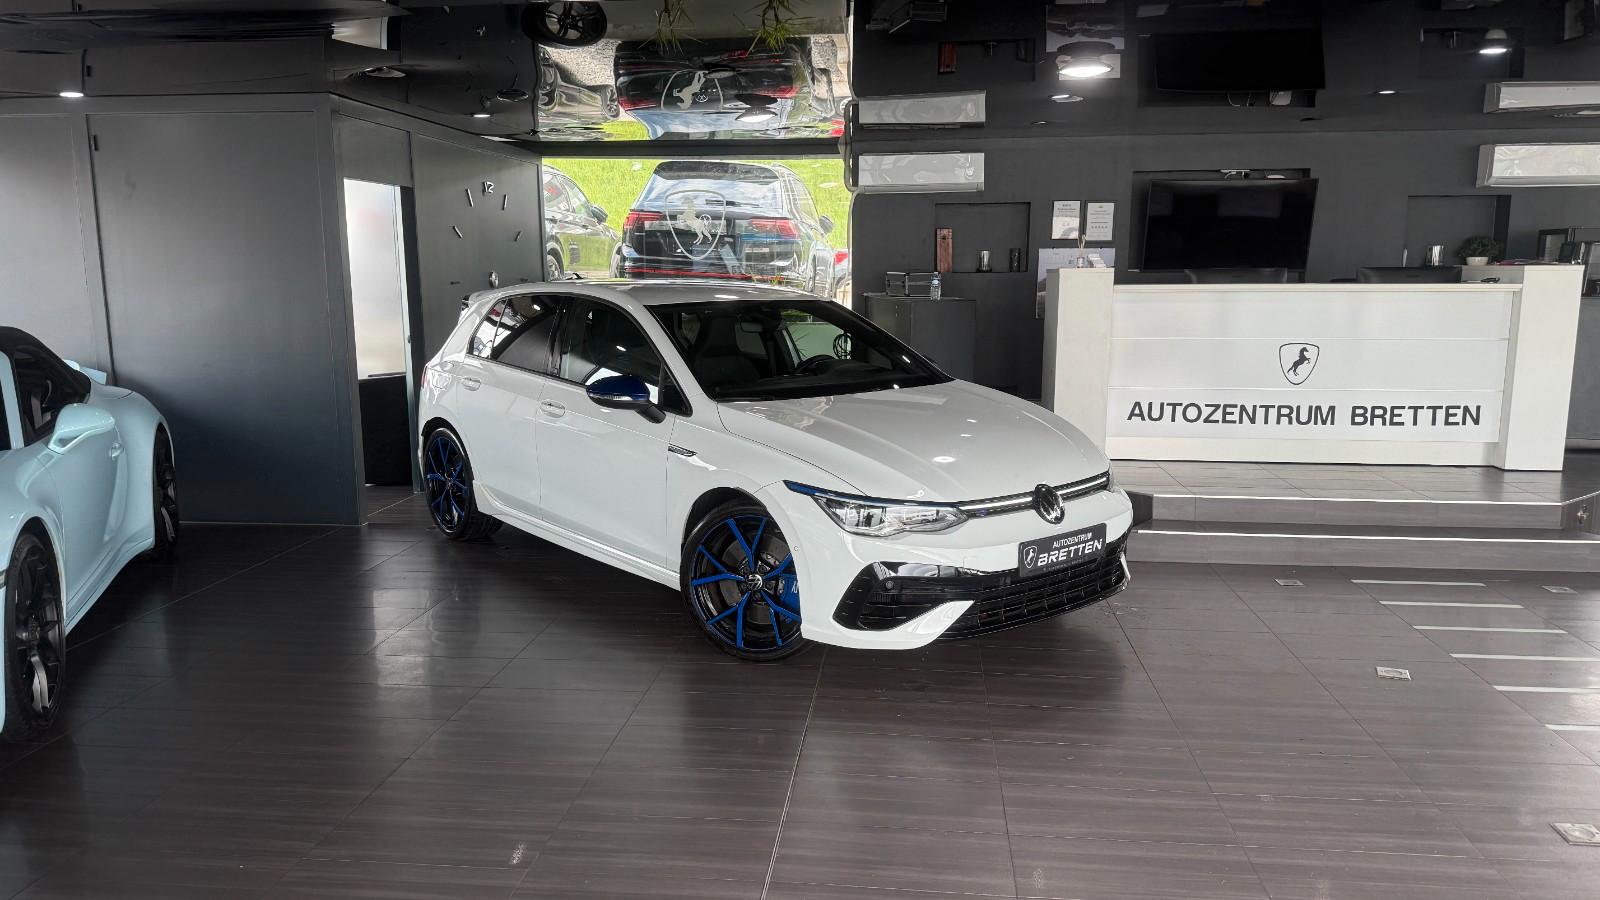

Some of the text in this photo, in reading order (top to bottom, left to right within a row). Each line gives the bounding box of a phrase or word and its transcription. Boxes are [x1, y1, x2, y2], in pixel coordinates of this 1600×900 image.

[1127, 401, 1482, 426] AUTOZENTRUM BRETTEN
[1037, 538, 1103, 567] BRETTEN
[1052, 532, 1093, 549] AUTOZENTRUM
